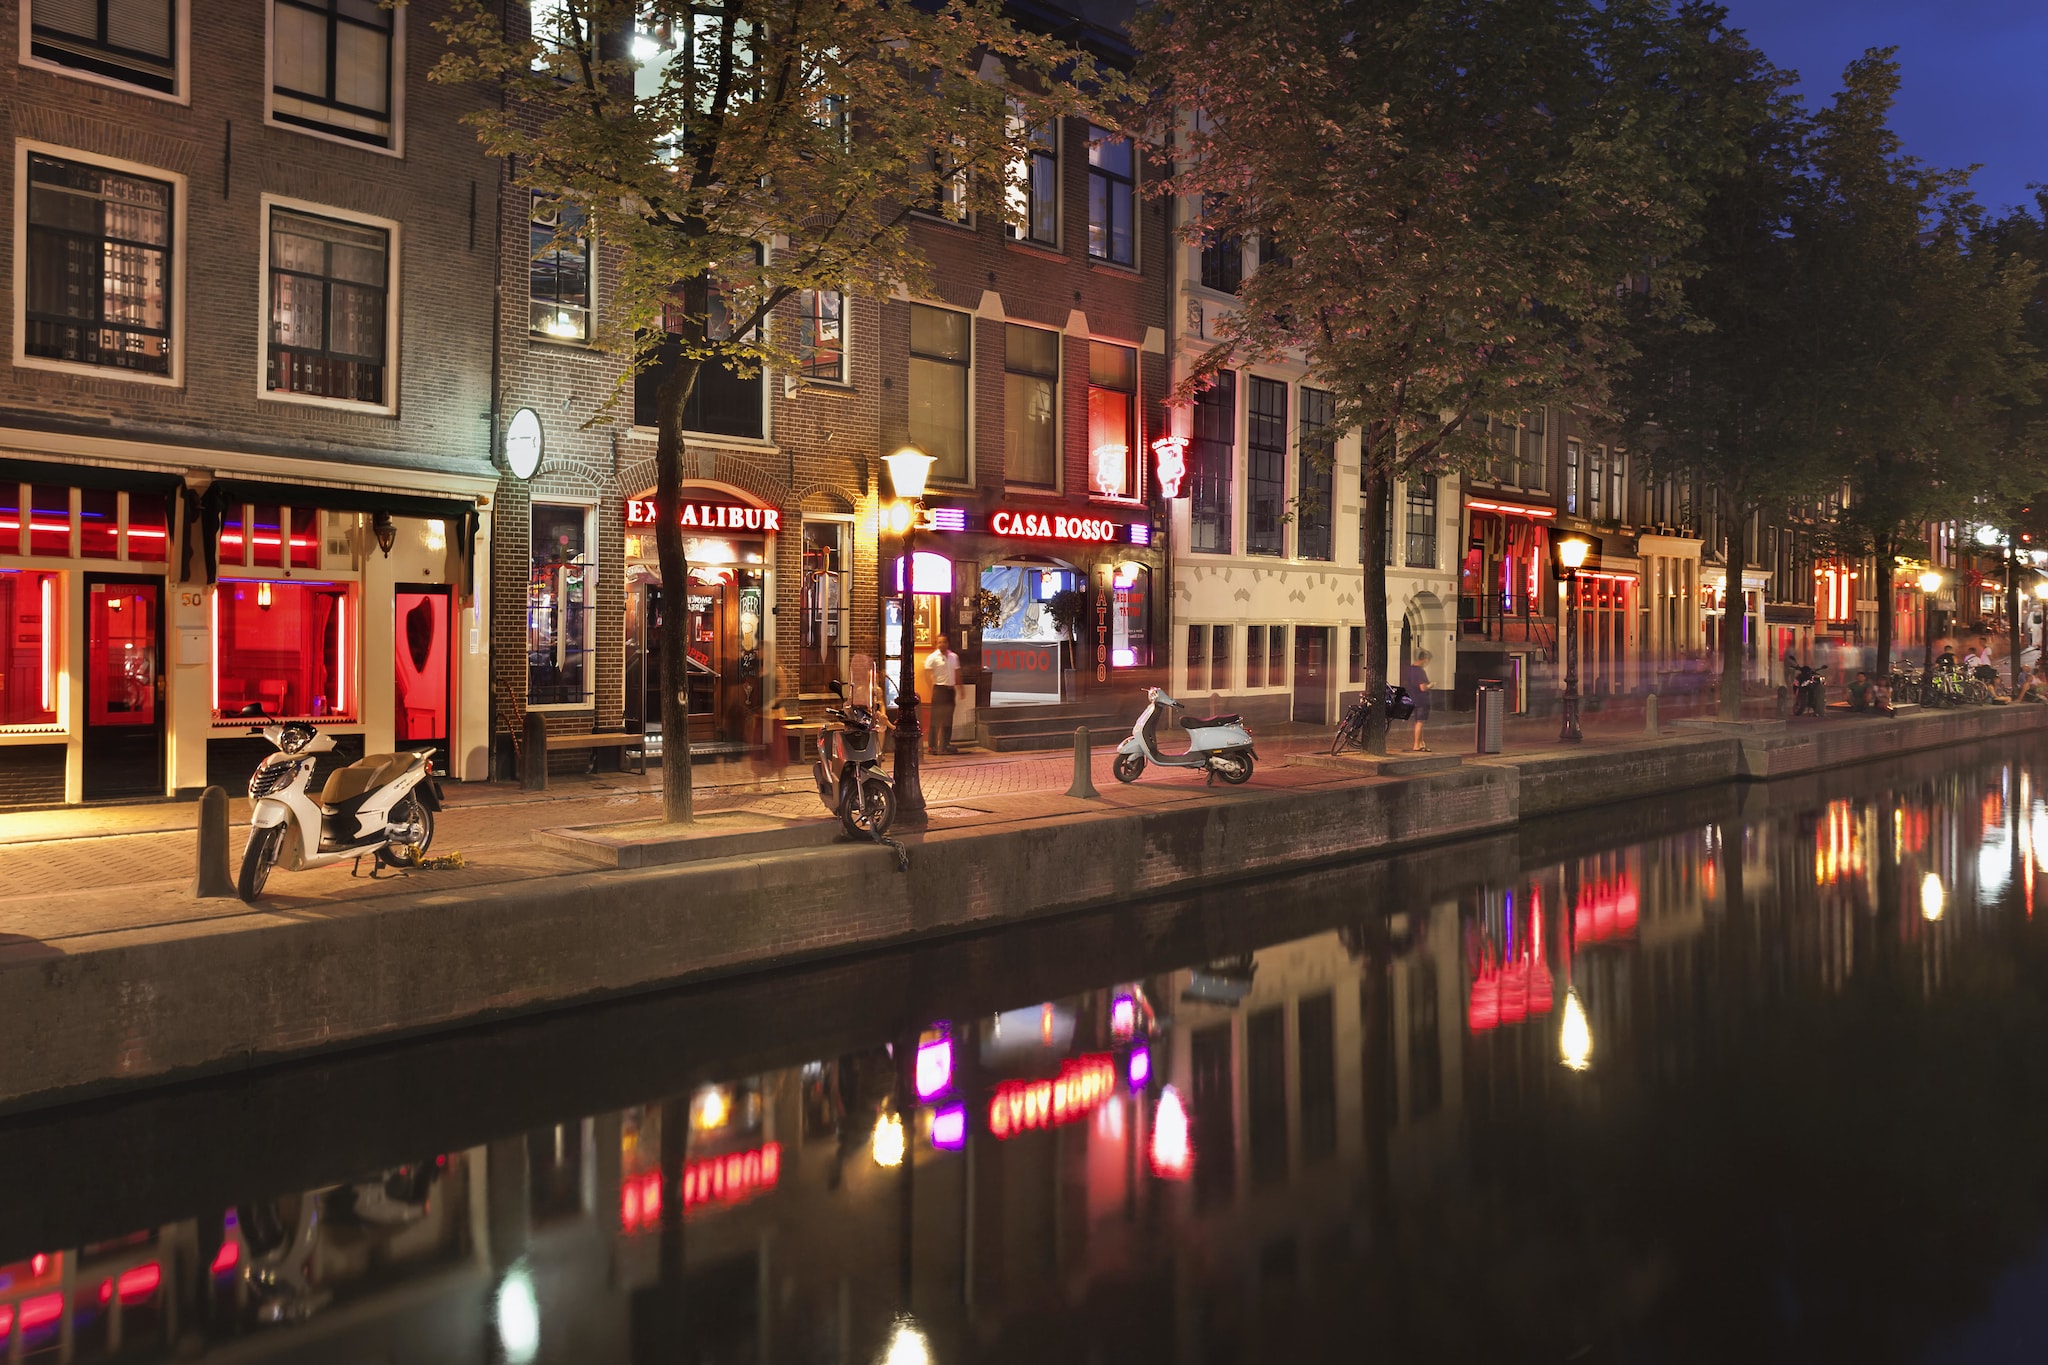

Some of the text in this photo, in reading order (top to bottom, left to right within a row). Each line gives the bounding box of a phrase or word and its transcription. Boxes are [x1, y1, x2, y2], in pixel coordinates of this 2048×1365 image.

[627, 500, 780, 531] EXALIBUR
[993, 512, 1114, 541] CASA ROSSO
[110, 585, 138, 595] Airco
[182, 593, 202, 606] 50
[741, 595, 760, 616] BEER
[1096, 571, 1107, 682] TATTOO
[995, 649, 1051, 672] TATTOO
